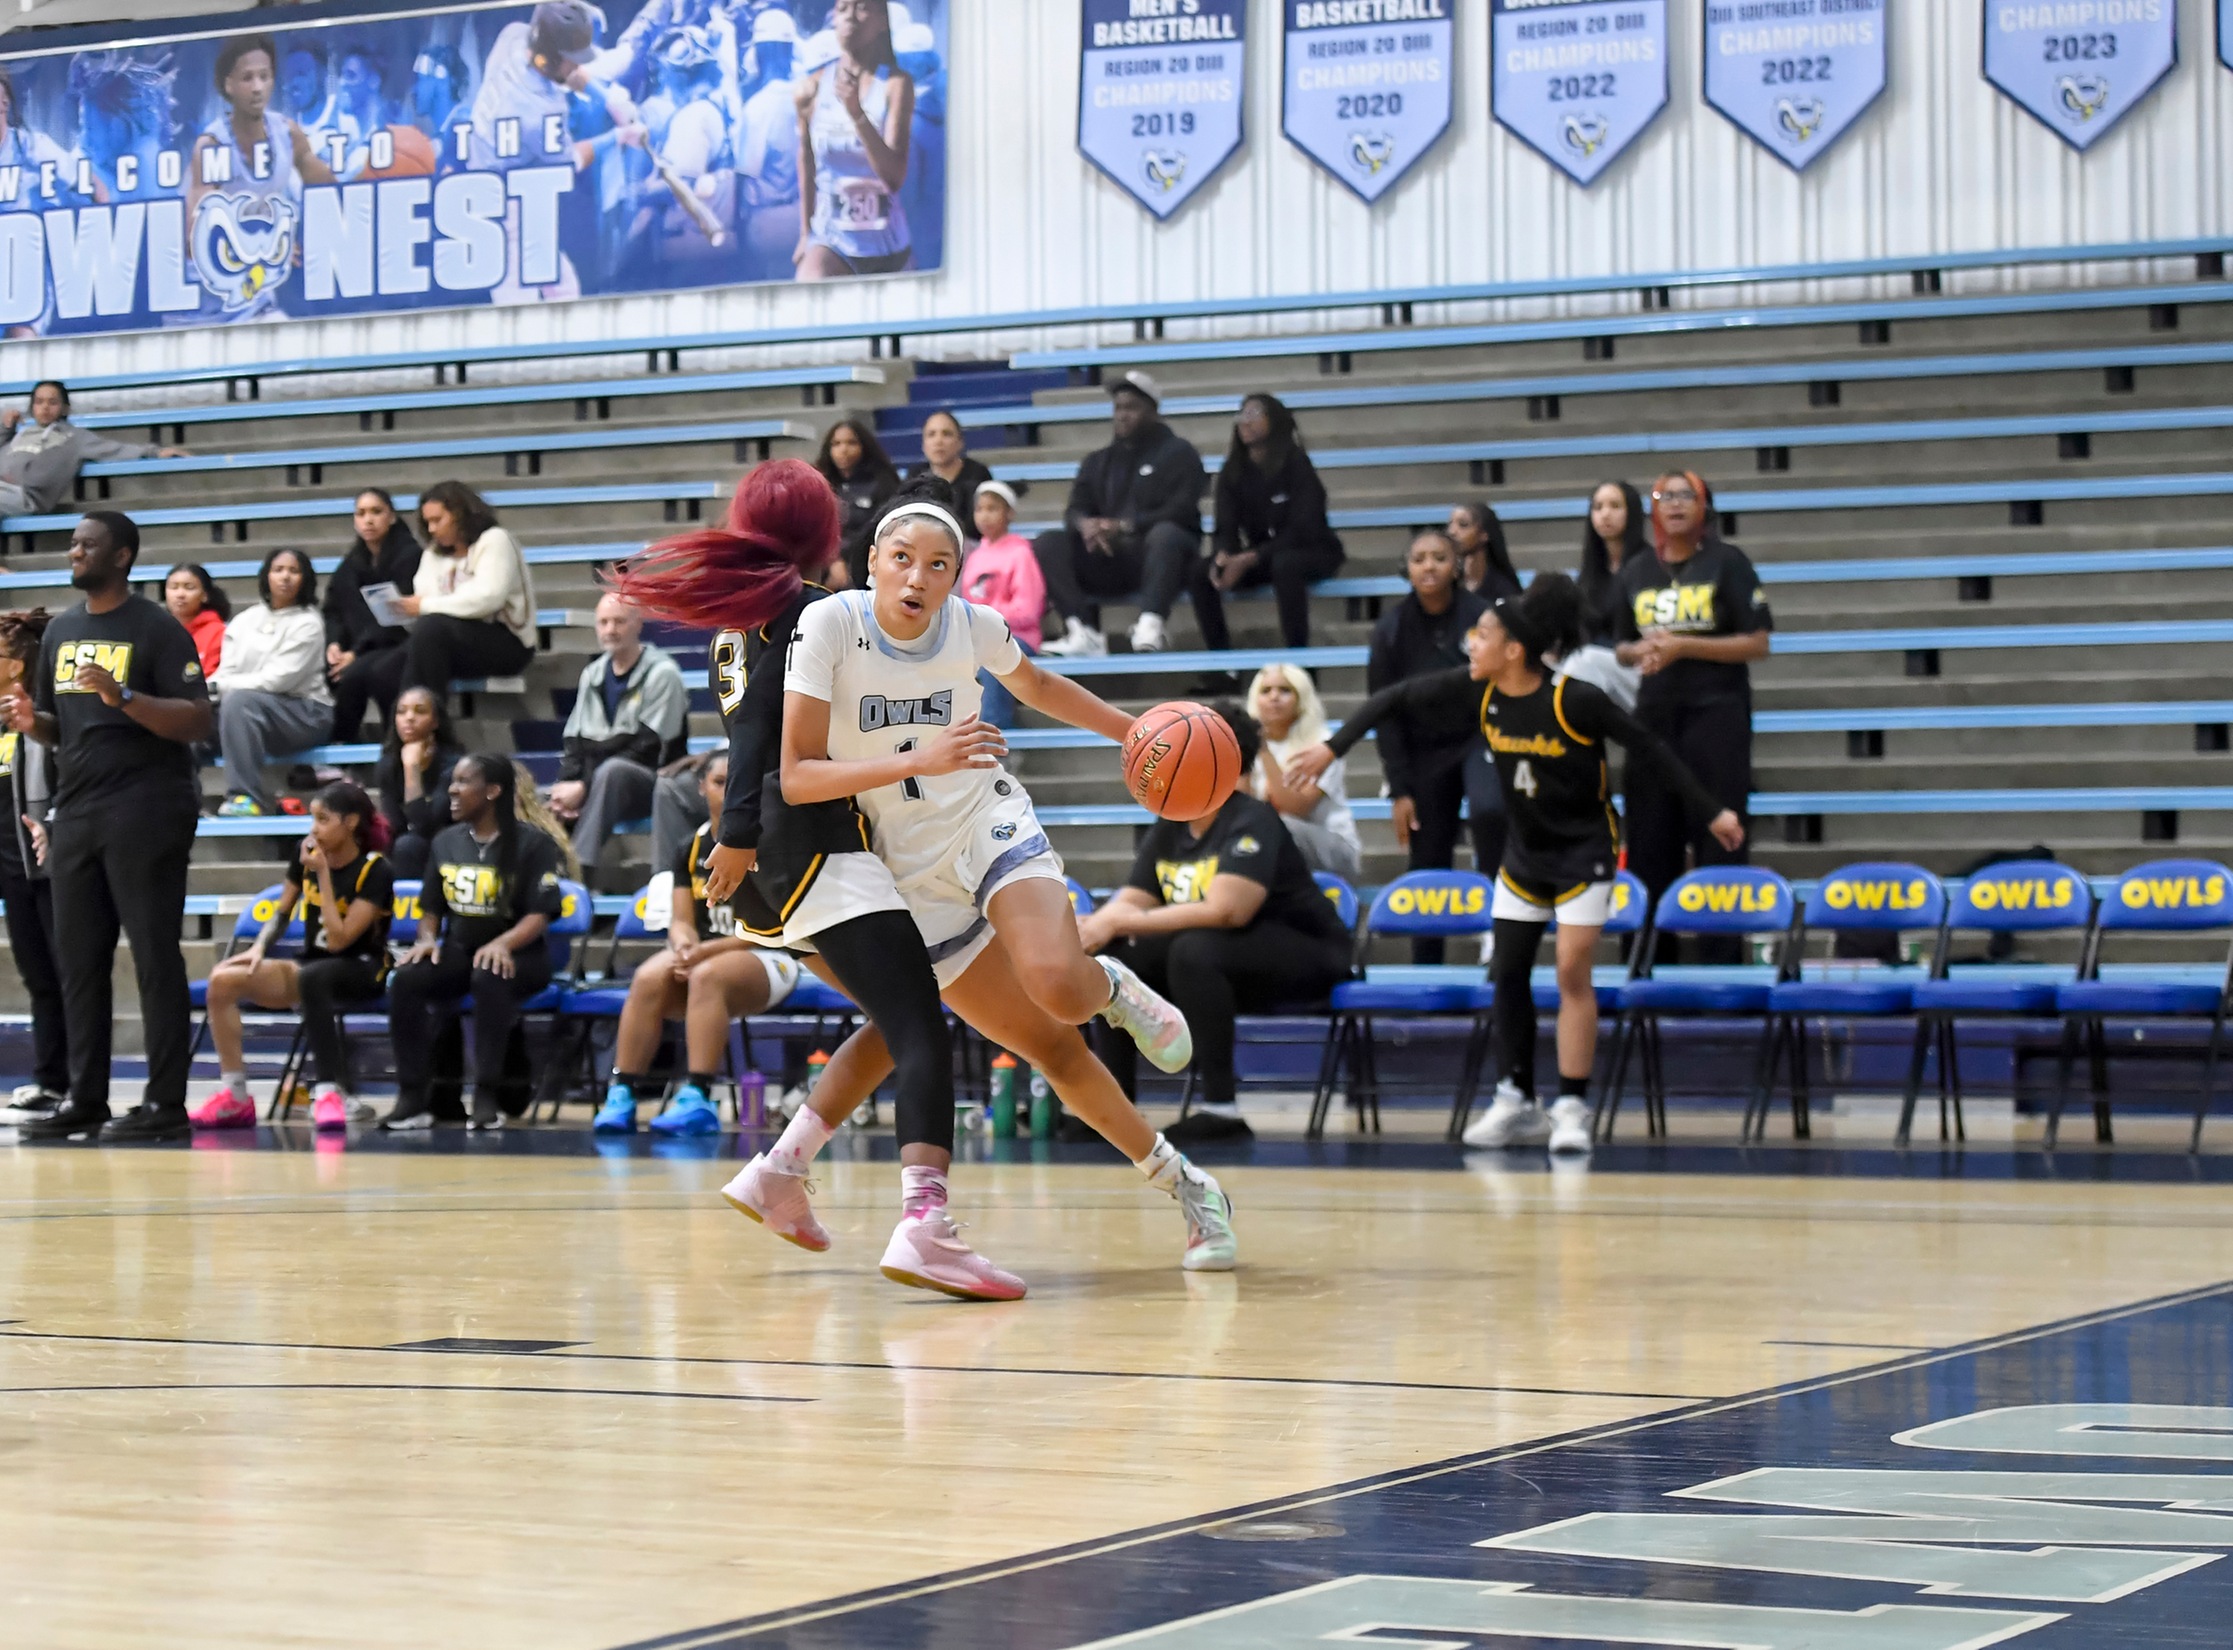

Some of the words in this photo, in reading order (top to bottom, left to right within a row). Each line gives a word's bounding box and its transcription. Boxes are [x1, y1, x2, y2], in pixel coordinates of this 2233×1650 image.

[1129, 0, 1199, 18] MENS
[1296, 0, 1445, 28] BASKETBALL
[2000, 0, 2161, 32] CHAMPIONS
[1093, 13, 1236, 47] BASKETBALL
[1517, 20, 1578, 39] REGION
[1585, 16, 1608, 34] 20
[1719, 21, 1873, 56] CHAMPIONS
[1308, 38, 1367, 59] REGION
[1374, 36, 1395, 54] 20
[1506, 38, 1655, 73] CHAMPIONS
[2044, 33, 2117, 62] 2023
[1105, 59, 1162, 77] REGION
[1169, 56, 1189, 74] 20
[1298, 58, 1441, 90] CHAMPIONS
[1762, 55, 1831, 85] 2022
[1094, 79, 1232, 108] CHAMPIONS
[1548, 73, 1617, 101] 2022
[1337, 92, 1403, 120] 2020
[1131, 112, 1195, 137] 2019
[0, 142, 270, 201] WELCOME
[327, 130, 393, 174] TO
[453, 114, 563, 161] THE
[0, 199, 200, 324] OWL
[304, 165, 575, 301] NEST
[1635, 584, 1714, 627] CSM
[56, 643, 130, 683] CSM
[860, 688, 954, 733] OWLS
[1513, 759, 1537, 798] 4
[1388, 885, 1485, 915] OWLS
[1678, 883, 1777, 912] OWLS
[1825, 879, 1926, 910] OWLS
[1970, 877, 2073, 910] OWLS
[2121, 875, 2225, 909] OWLS
